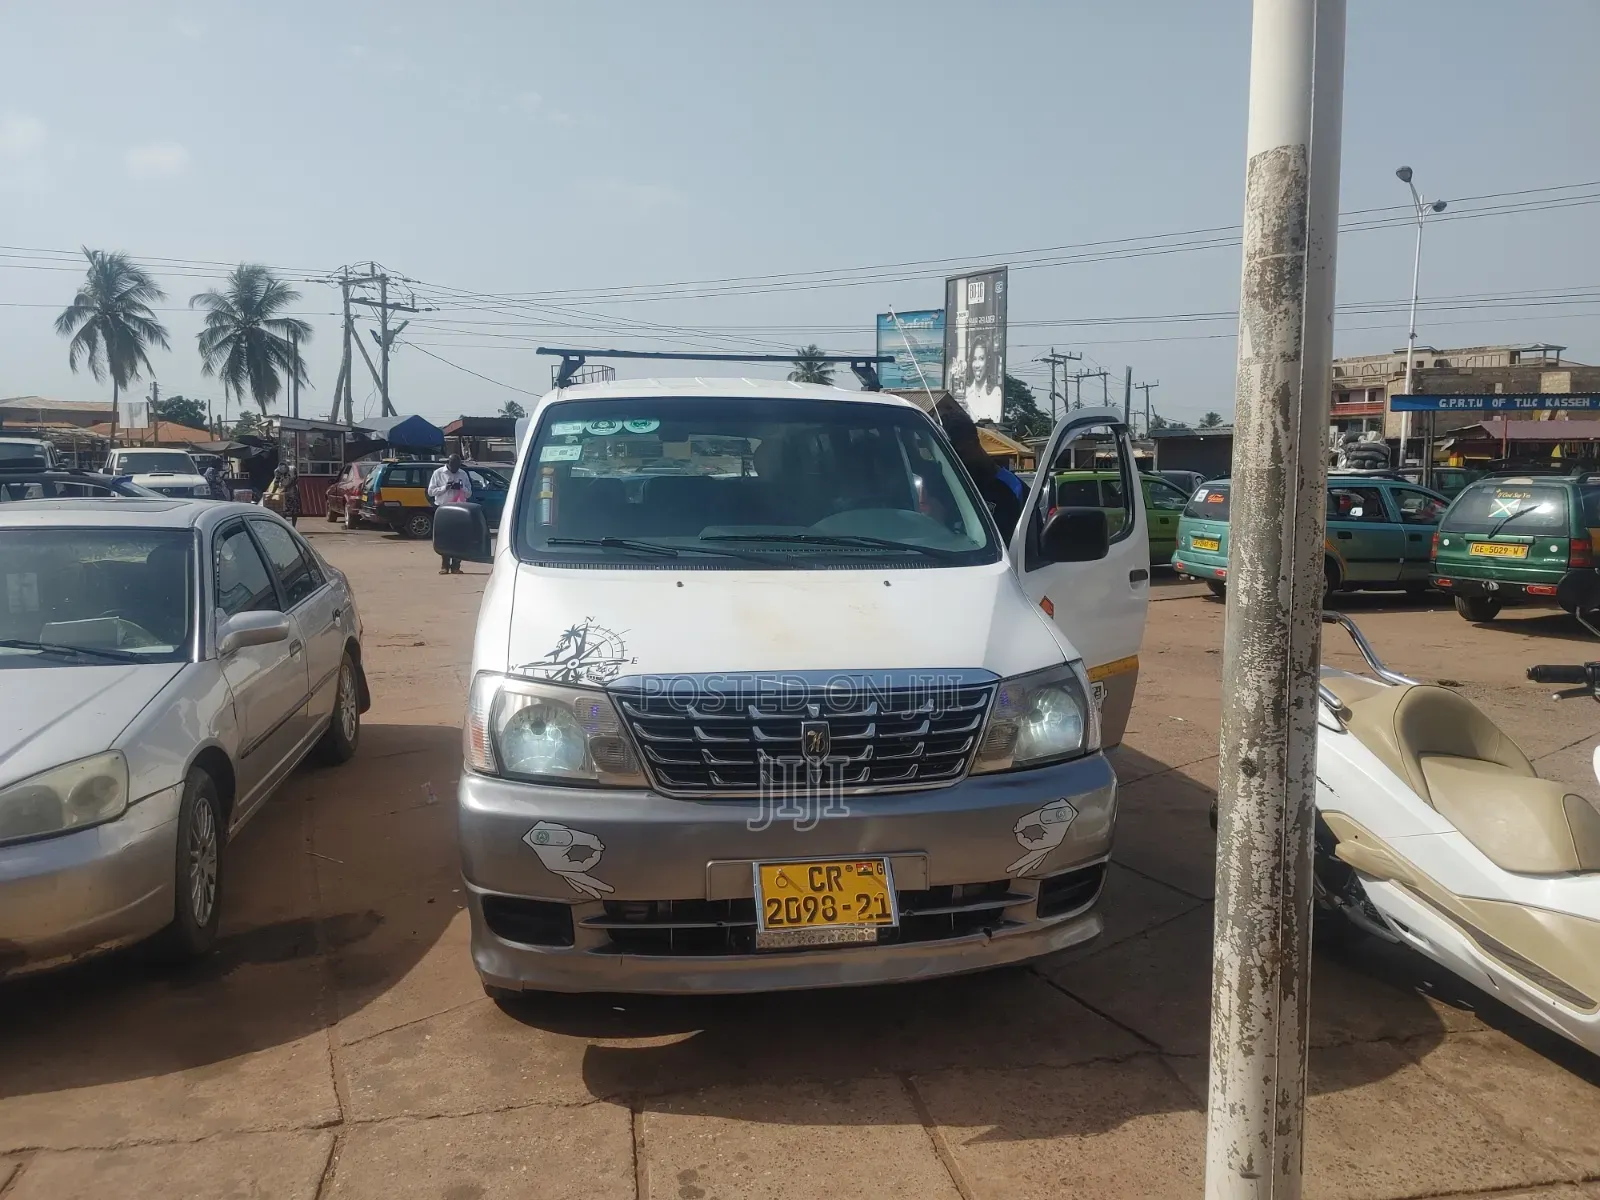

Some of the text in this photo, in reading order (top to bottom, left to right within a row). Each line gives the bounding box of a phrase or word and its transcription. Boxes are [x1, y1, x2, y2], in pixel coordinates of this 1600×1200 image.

[1492, 398, 1506, 407] OF
[1545, 397, 1590, 407] KASSEH
[807, 865, 843, 892] CR
[766, 893, 892, 925] 2098-21
